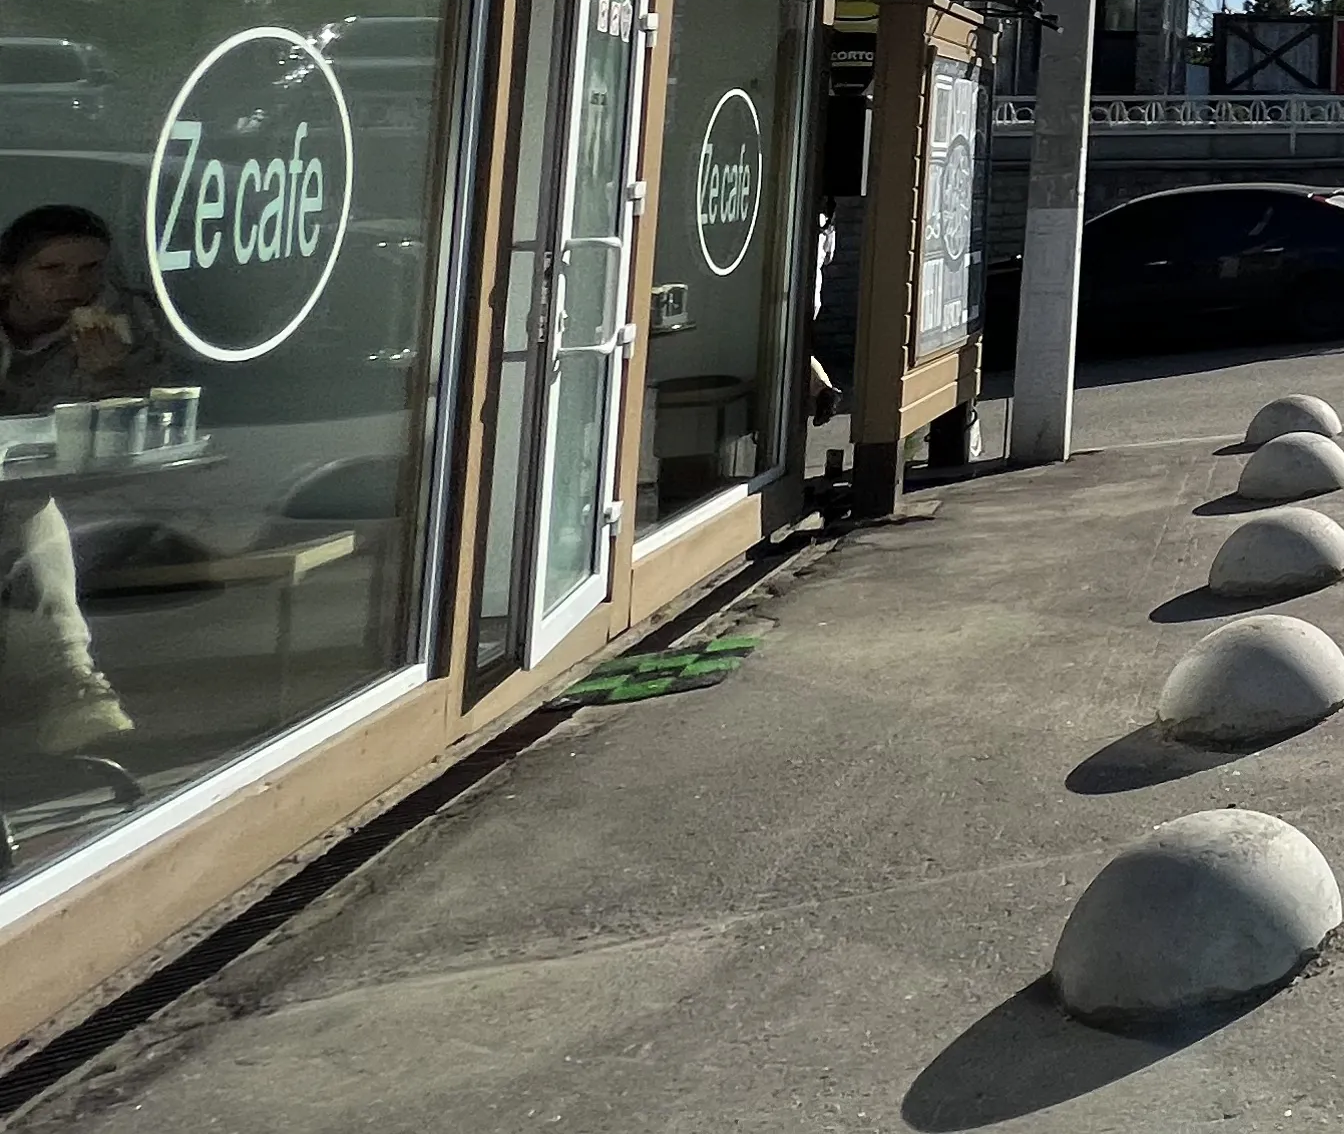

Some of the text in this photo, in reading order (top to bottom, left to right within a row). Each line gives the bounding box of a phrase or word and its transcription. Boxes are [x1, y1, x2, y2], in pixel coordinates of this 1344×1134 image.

[830, 50, 875, 61] CORTO
[158, 119, 325, 272] Ze cafe
[699, 142, 751, 226] Ze cafe
